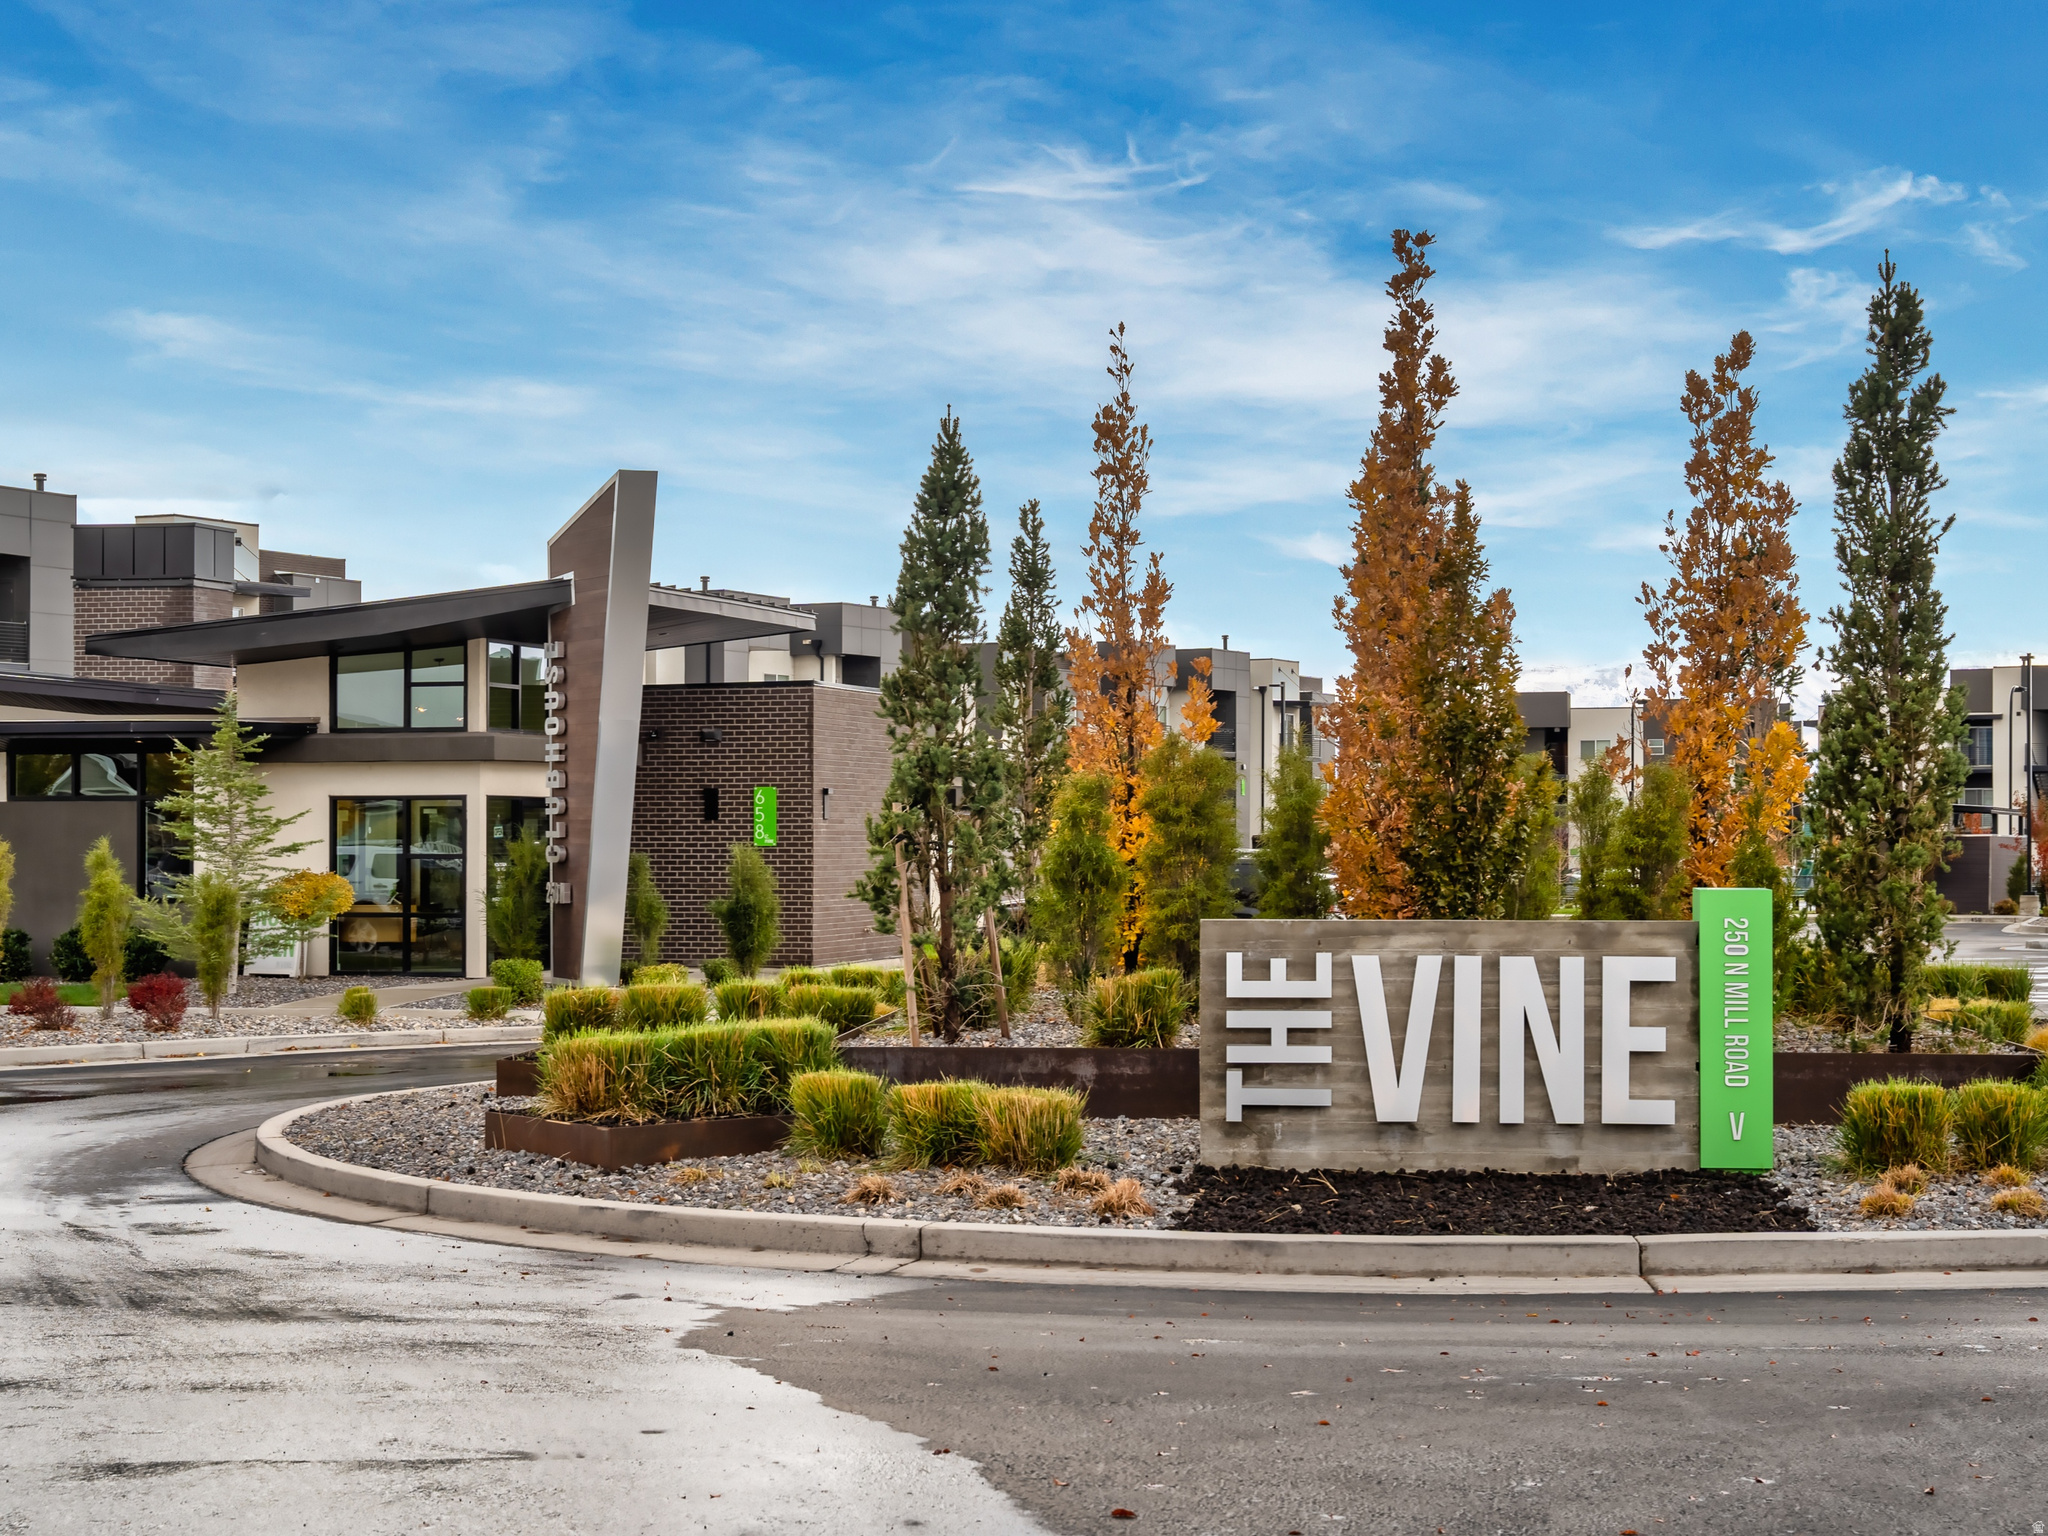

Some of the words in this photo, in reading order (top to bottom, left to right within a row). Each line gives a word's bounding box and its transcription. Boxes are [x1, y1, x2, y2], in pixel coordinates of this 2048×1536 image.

[544, 641, 566, 863] CLUBHOUSE
[755, 789, 765, 839] 658
[1723, 917, 1749, 956] 250
[1724, 963, 1749, 975] N
[1724, 982, 1749, 1029] MILL
[1226, 952, 1332, 1122] THE
[1351, 955, 1677, 1125] VINE
[1724, 1035, 1749, 1087] ROAD
[1729, 1112, 1745, 1141] V
